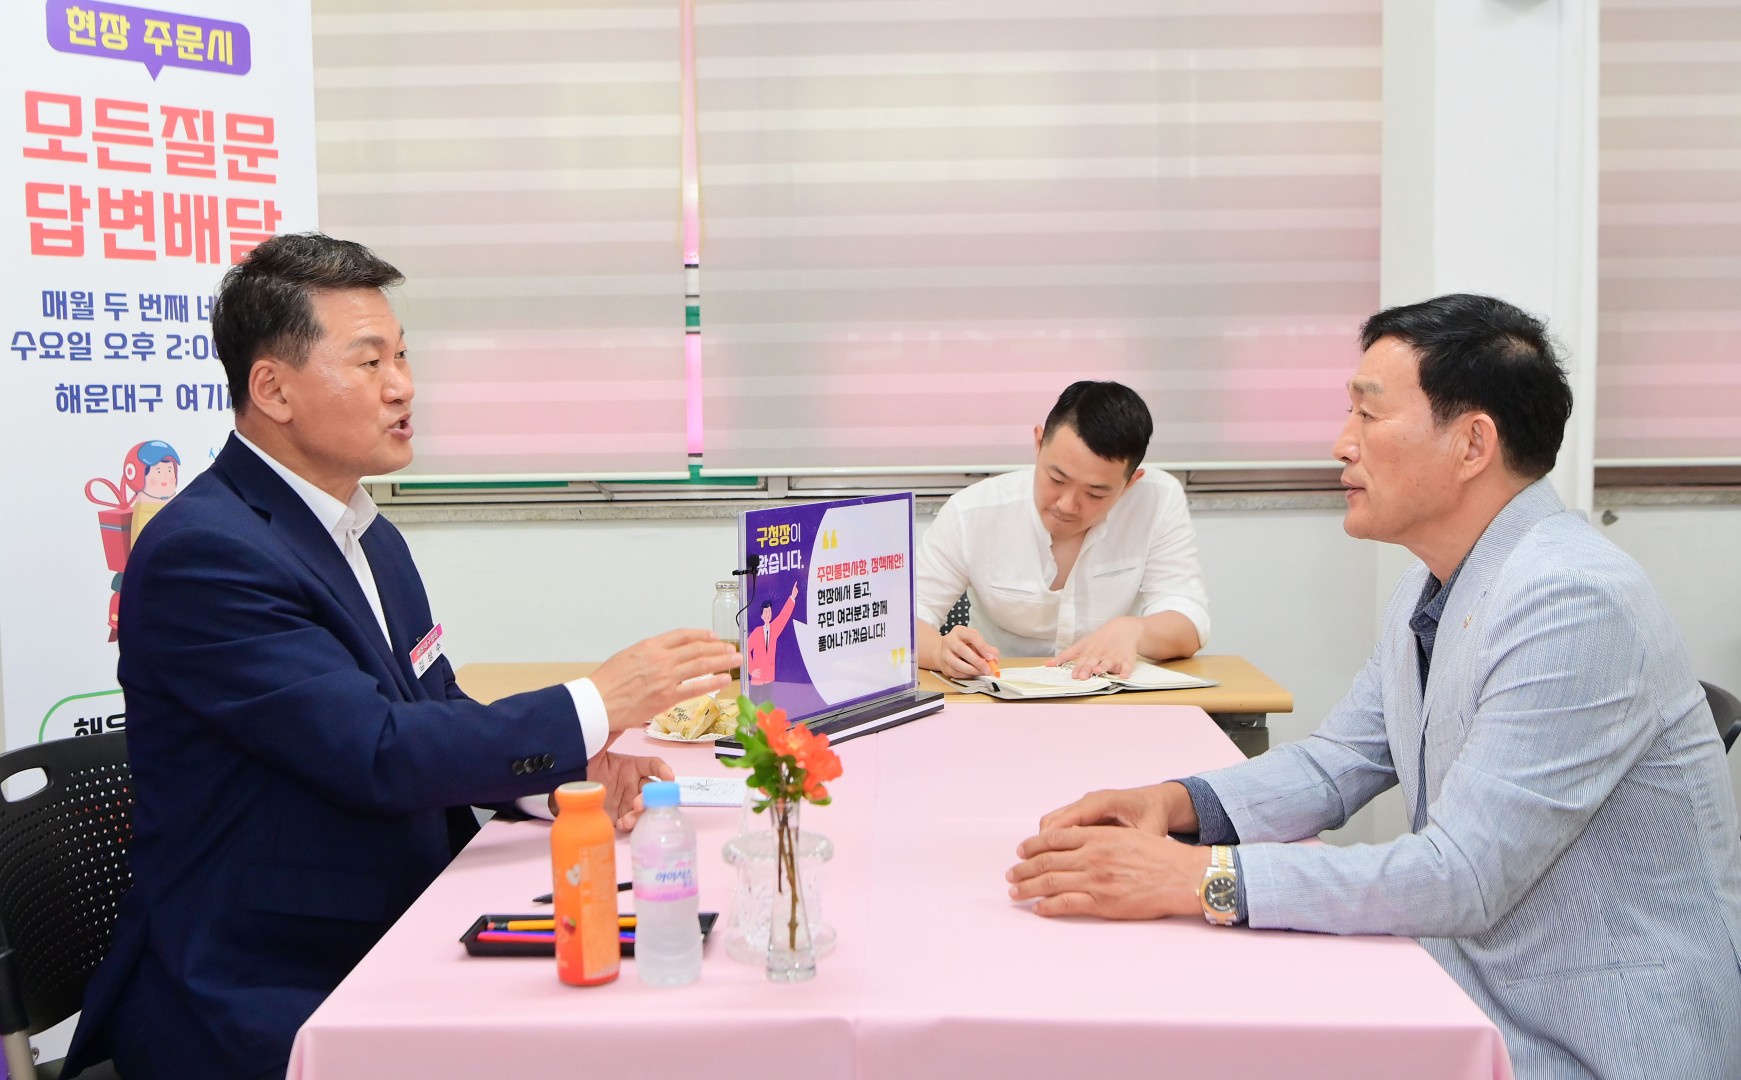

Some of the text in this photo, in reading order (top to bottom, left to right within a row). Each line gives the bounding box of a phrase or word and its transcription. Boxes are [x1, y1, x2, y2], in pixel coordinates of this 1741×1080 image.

[66, 5, 233, 66] 현장 주문시
[23, 90, 279, 184] 모든질문
[25, 181, 283, 265] 답변배달
[41, 290, 95, 321] 매월
[104, 292, 130, 322] 두
[139, 293, 189, 323] 번째
[11, 331, 93, 361] 수요일
[104, 332, 157, 361] 오후
[55, 383, 163, 413] 해운대구
[756, 523, 801, 548] 구청장이
[817, 553, 905, 582] 주민불편사항, 정책제안!
[817, 582, 872, 606] 현장에서 듣고,
[817, 600, 887, 628] 주민 여러분과 함께
[817, 622, 886, 652] 풀어나가겠습니다!
